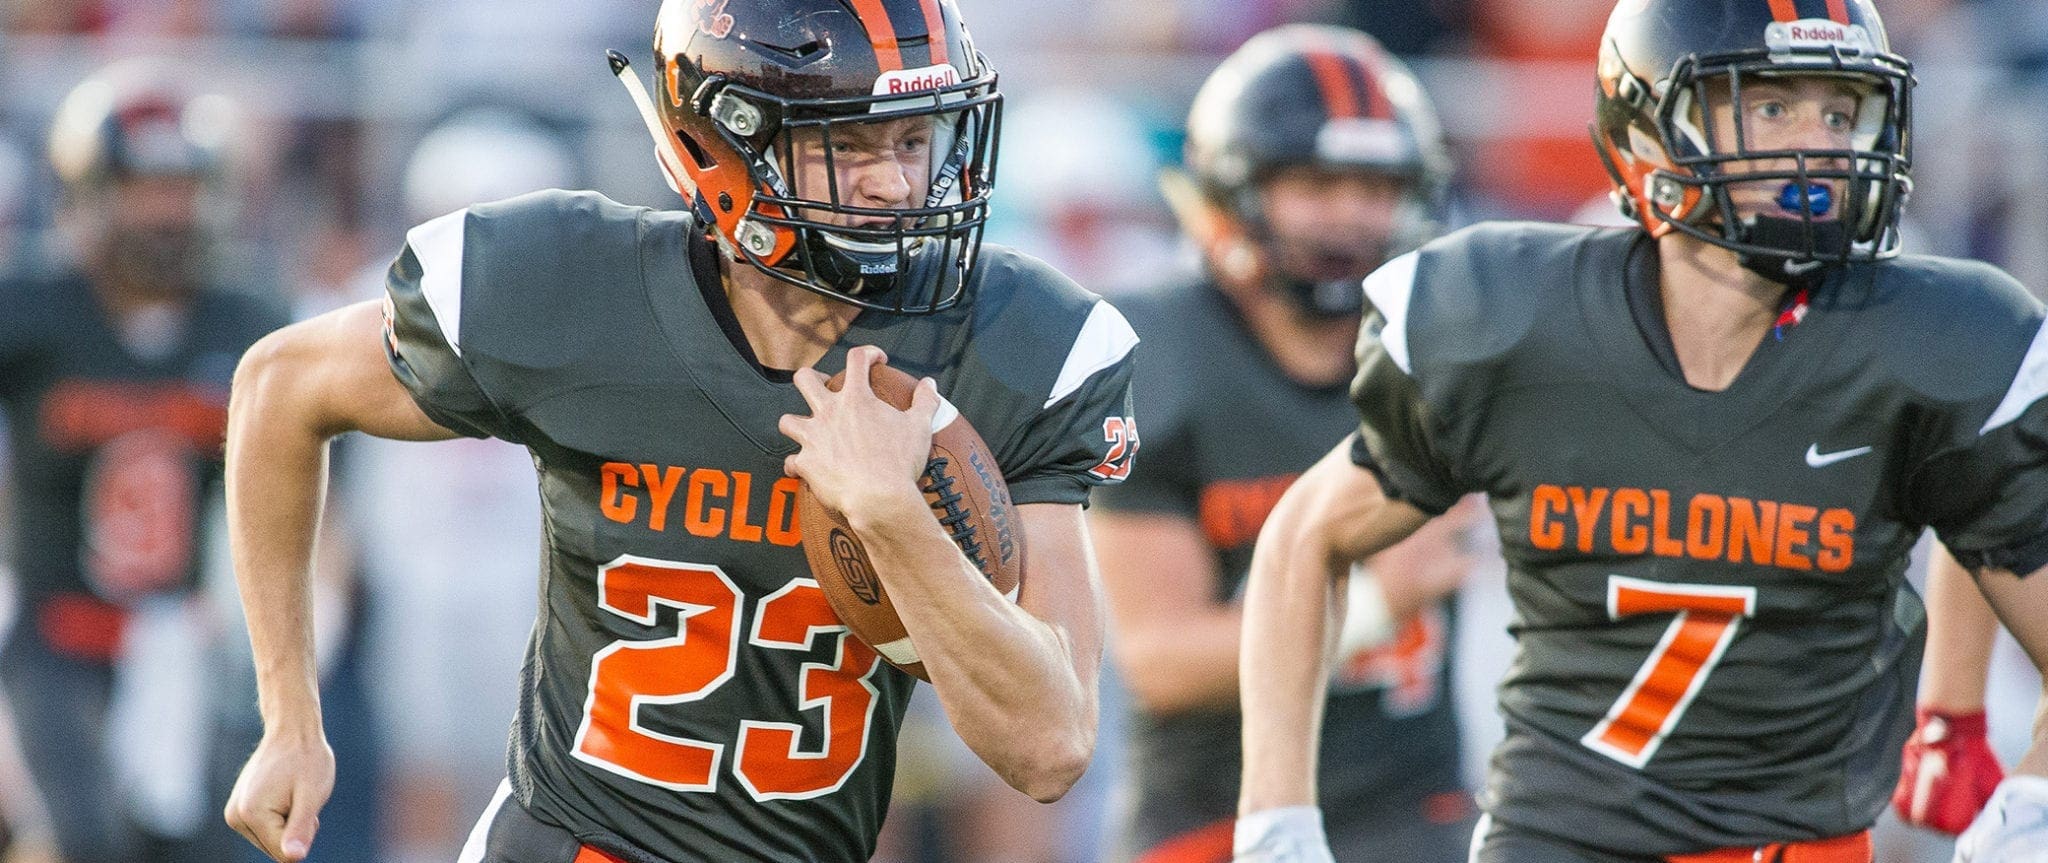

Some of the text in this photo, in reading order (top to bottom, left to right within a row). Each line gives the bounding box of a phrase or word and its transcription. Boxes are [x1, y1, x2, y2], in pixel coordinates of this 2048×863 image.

[1791, 26, 1844, 41] Riddell
[888, 70, 954, 94] Riddell
[860, 264, 898, 275] Riddell
[1088, 416, 1141, 480] 23
[1529, 484, 1855, 573] CYCLONES
[571, 553, 881, 802] 23
[1581, 575, 1757, 769] 7
